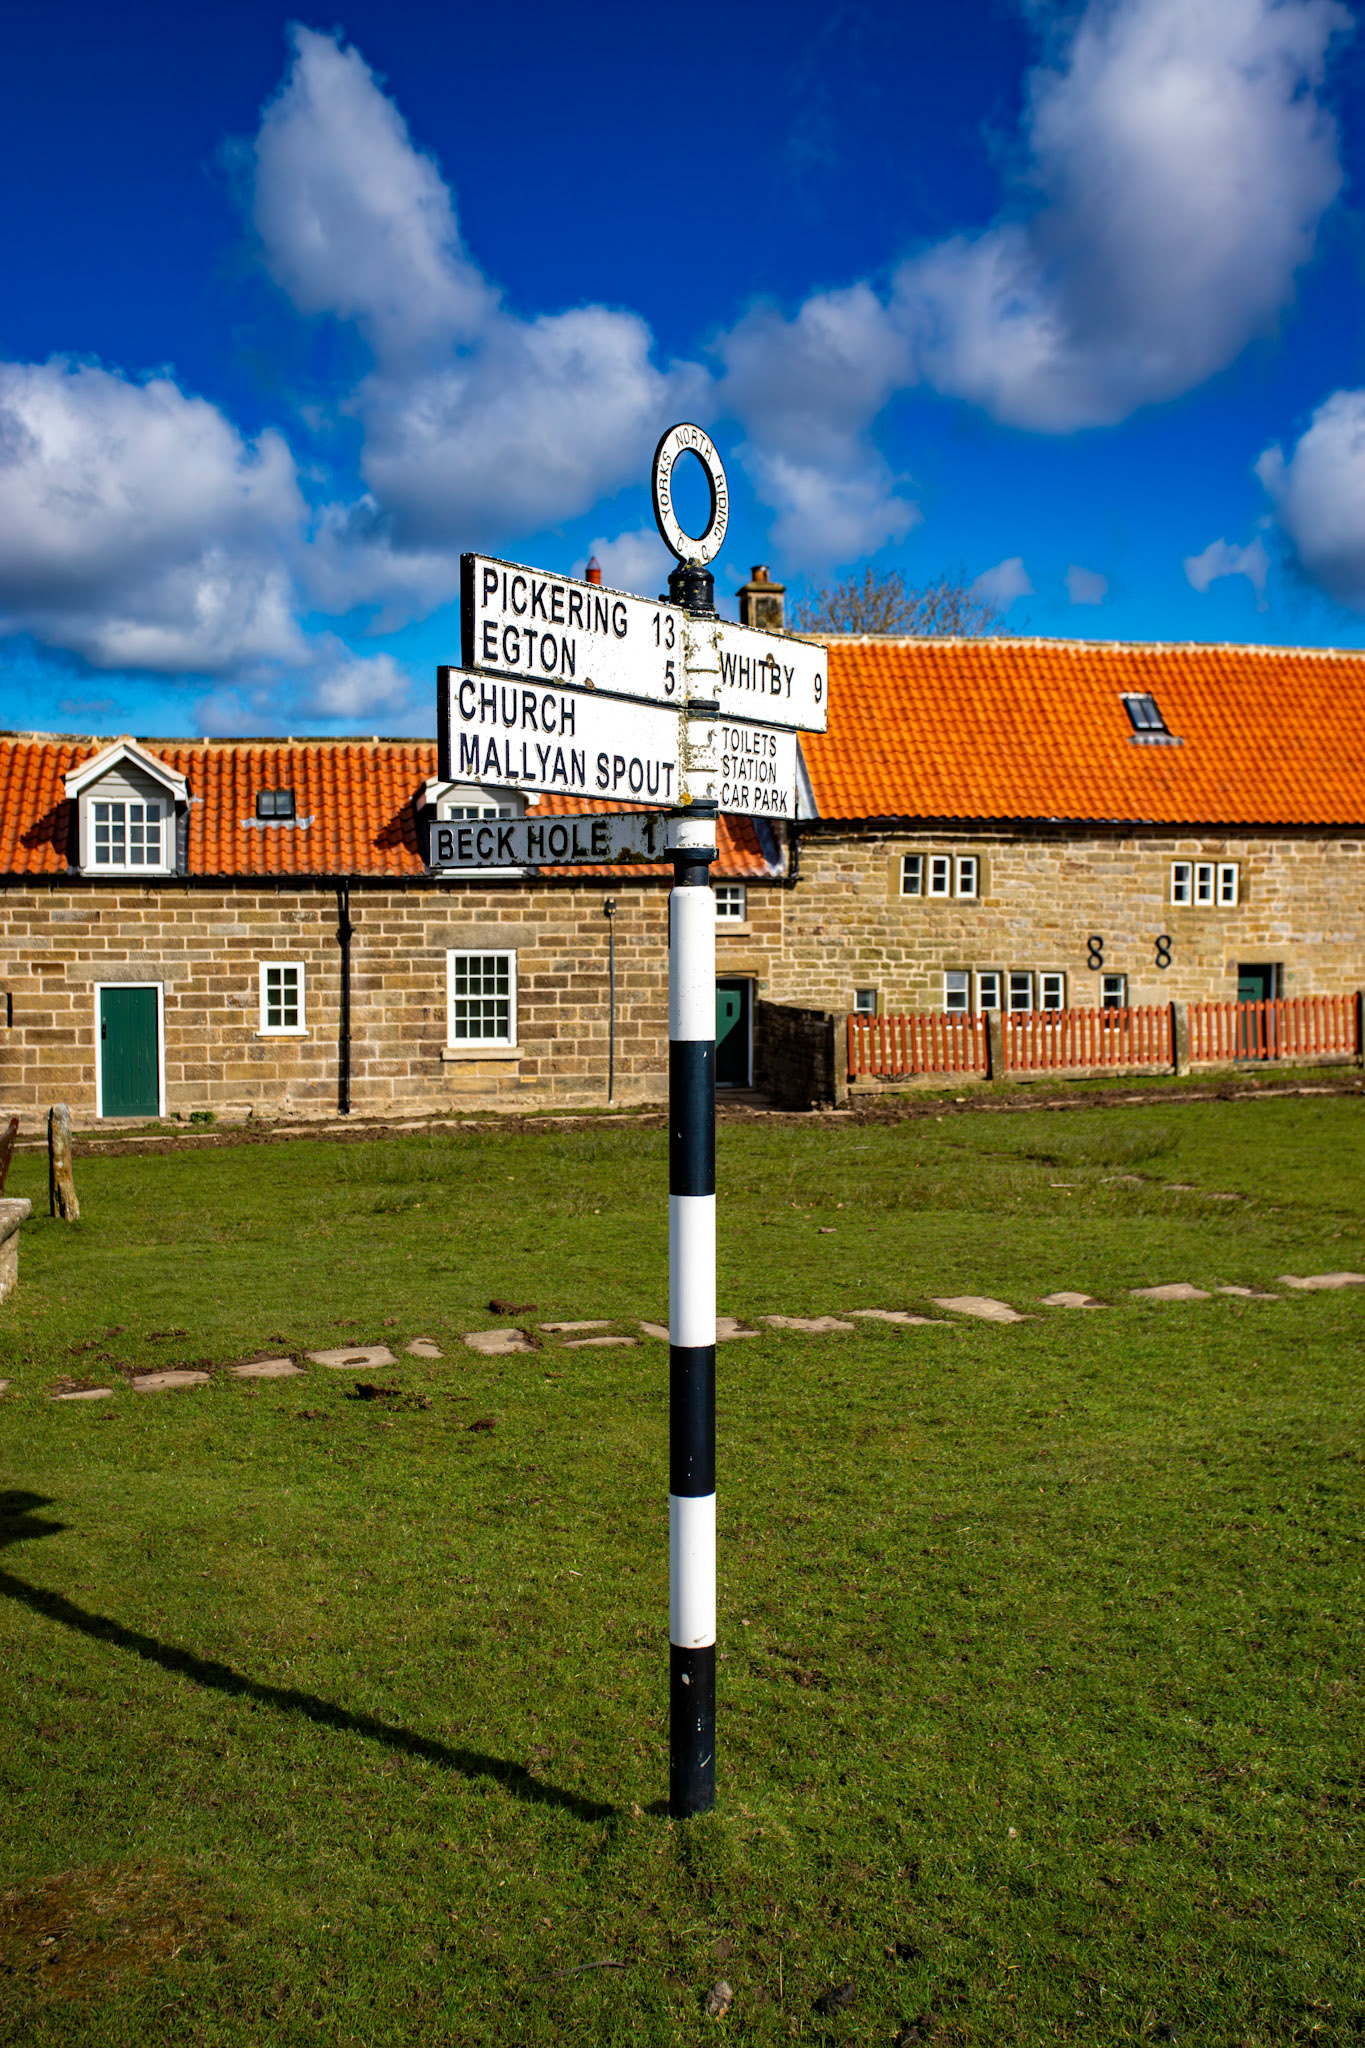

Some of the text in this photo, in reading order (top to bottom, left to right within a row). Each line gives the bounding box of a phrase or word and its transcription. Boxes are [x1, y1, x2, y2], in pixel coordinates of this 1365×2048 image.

[675, 427, 714, 463] NORTH
[659, 451, 672, 521] YORKS
[714, 474, 727, 540] RIDING
[677, 536, 685, 552] C
[481, 567, 675, 650] PICKERING 13
[482, 620, 675, 696] EGTON 5
[720, 650, 823, 704] WHITBY 9
[458, 679, 576, 736] CHURCH
[458, 732, 675, 797] MALLYAN SPOUT
[722, 727, 777, 758] TOILETS
[722, 754, 777, 784] STATION
[722, 782, 788, 813] CAR PARK
[437, 816, 655, 861] BECK HOLE 1
